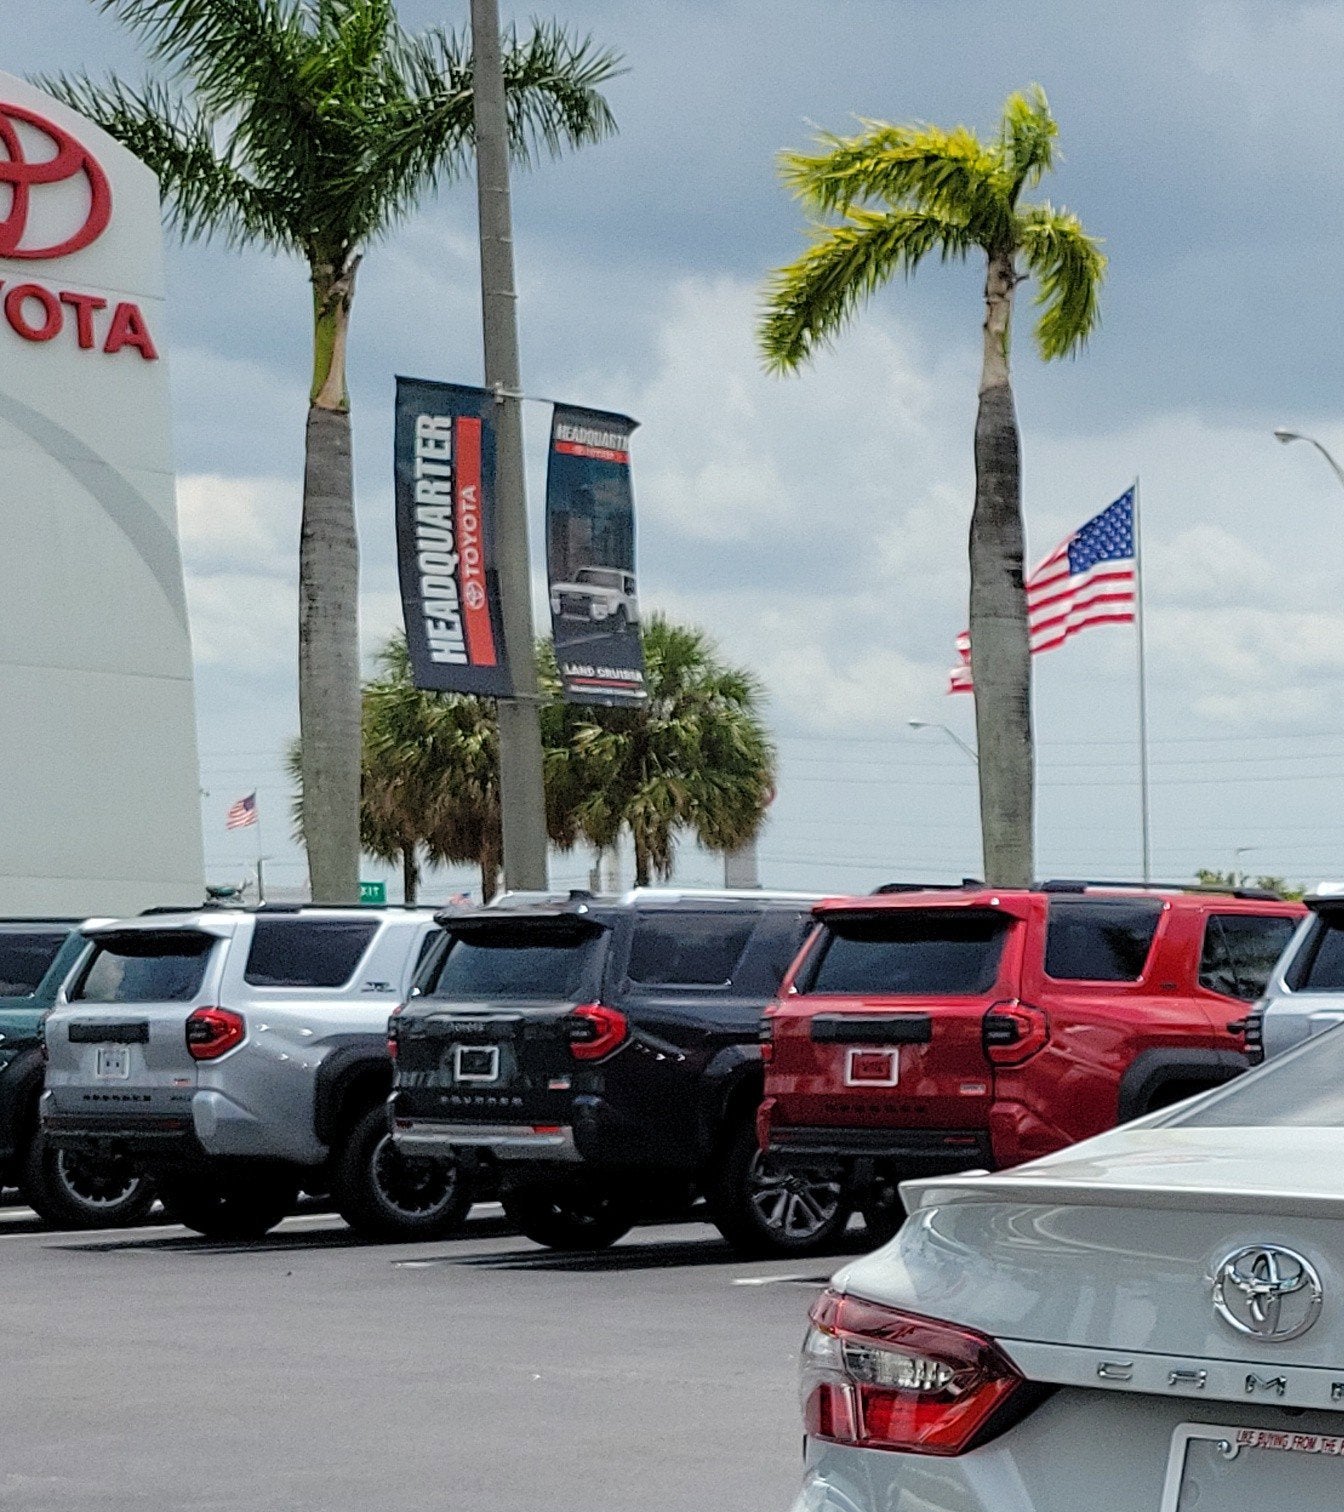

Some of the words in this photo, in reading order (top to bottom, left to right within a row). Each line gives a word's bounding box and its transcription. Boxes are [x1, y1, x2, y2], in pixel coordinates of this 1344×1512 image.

[0, 281, 159, 360] OTA
[556, 423, 628, 451] HEADQUART
[415, 415, 469, 664] HEADQUARTER
[461, 485, 479, 575] TOYOTA
[360, 886, 380, 896] XIT
[1293, 1435, 1318, 1449] FROM
[1321, 1438, 1336, 1451] THE
